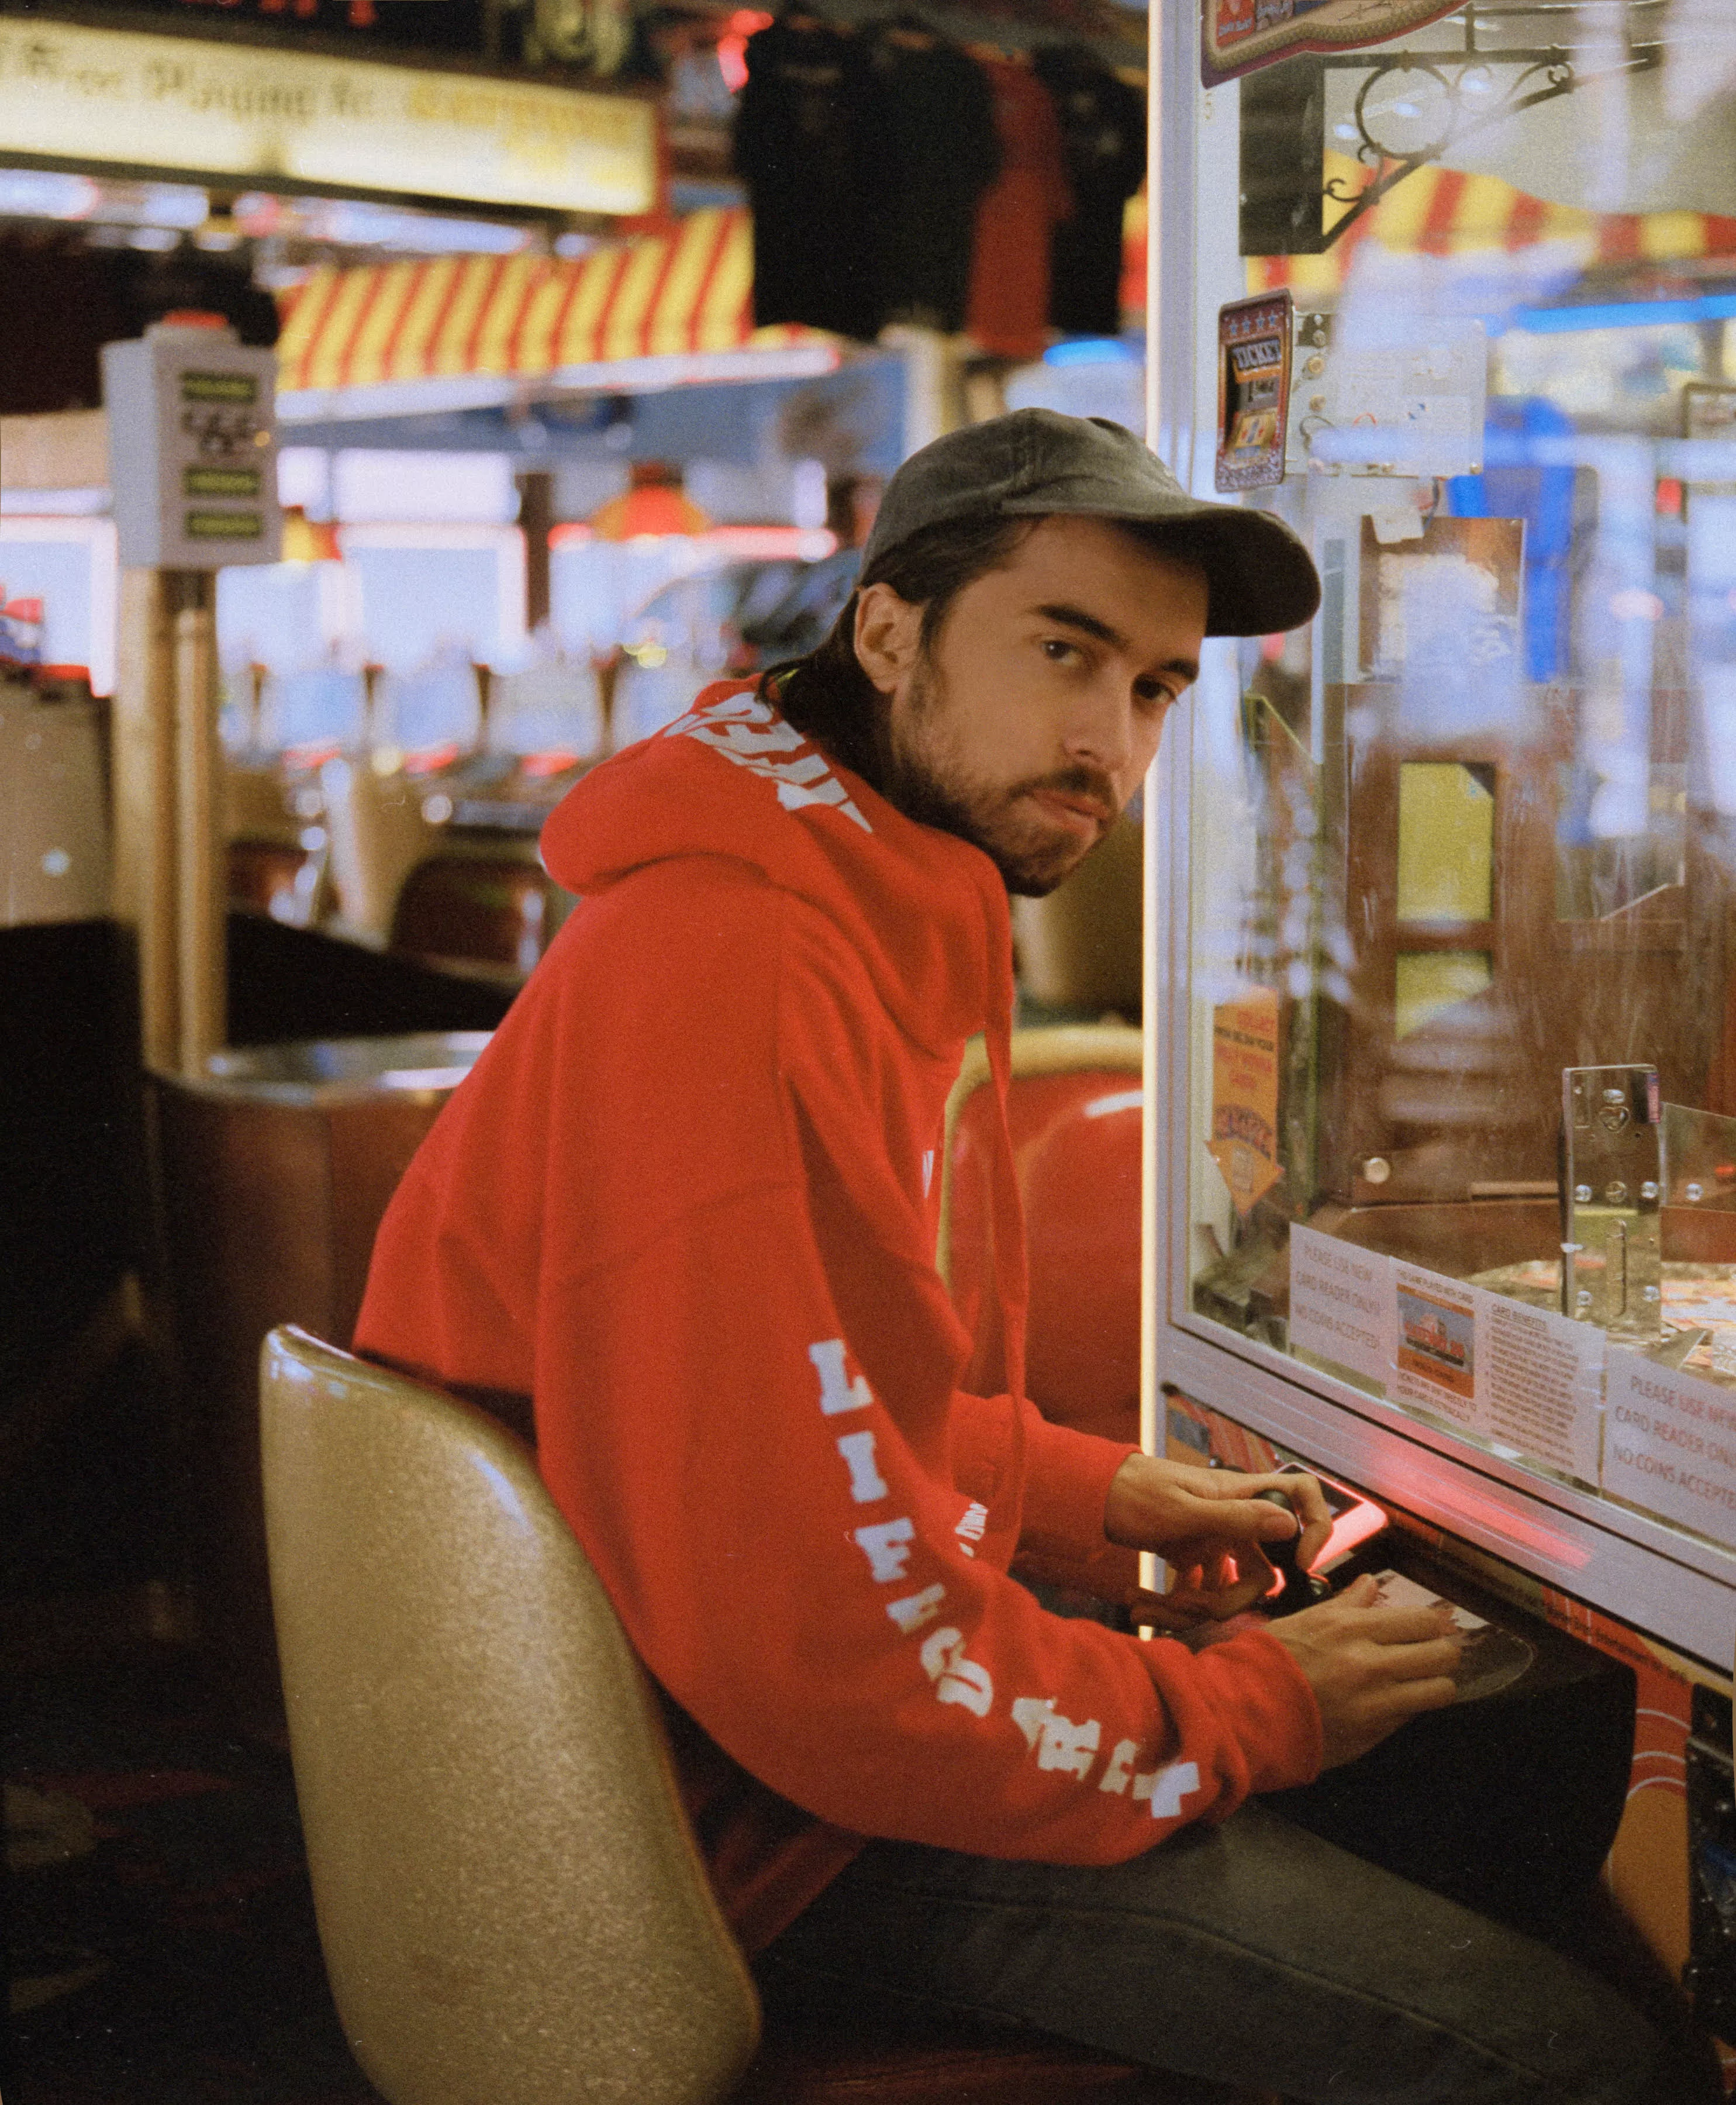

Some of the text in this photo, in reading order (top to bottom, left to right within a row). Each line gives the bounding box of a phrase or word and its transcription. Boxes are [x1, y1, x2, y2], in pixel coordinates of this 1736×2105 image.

[1492, 1303, 1511, 1317] CARD
[1631, 1374, 1679, 1408] PLEASE
[1679, 1394, 1705, 1419] USE
[1615, 1405, 1651, 1432] CARD
[1654, 1420, 1704, 1452] READER
[1613, 1444, 1634, 1465] NO
[1637, 1454, 1676, 1483] COINS
